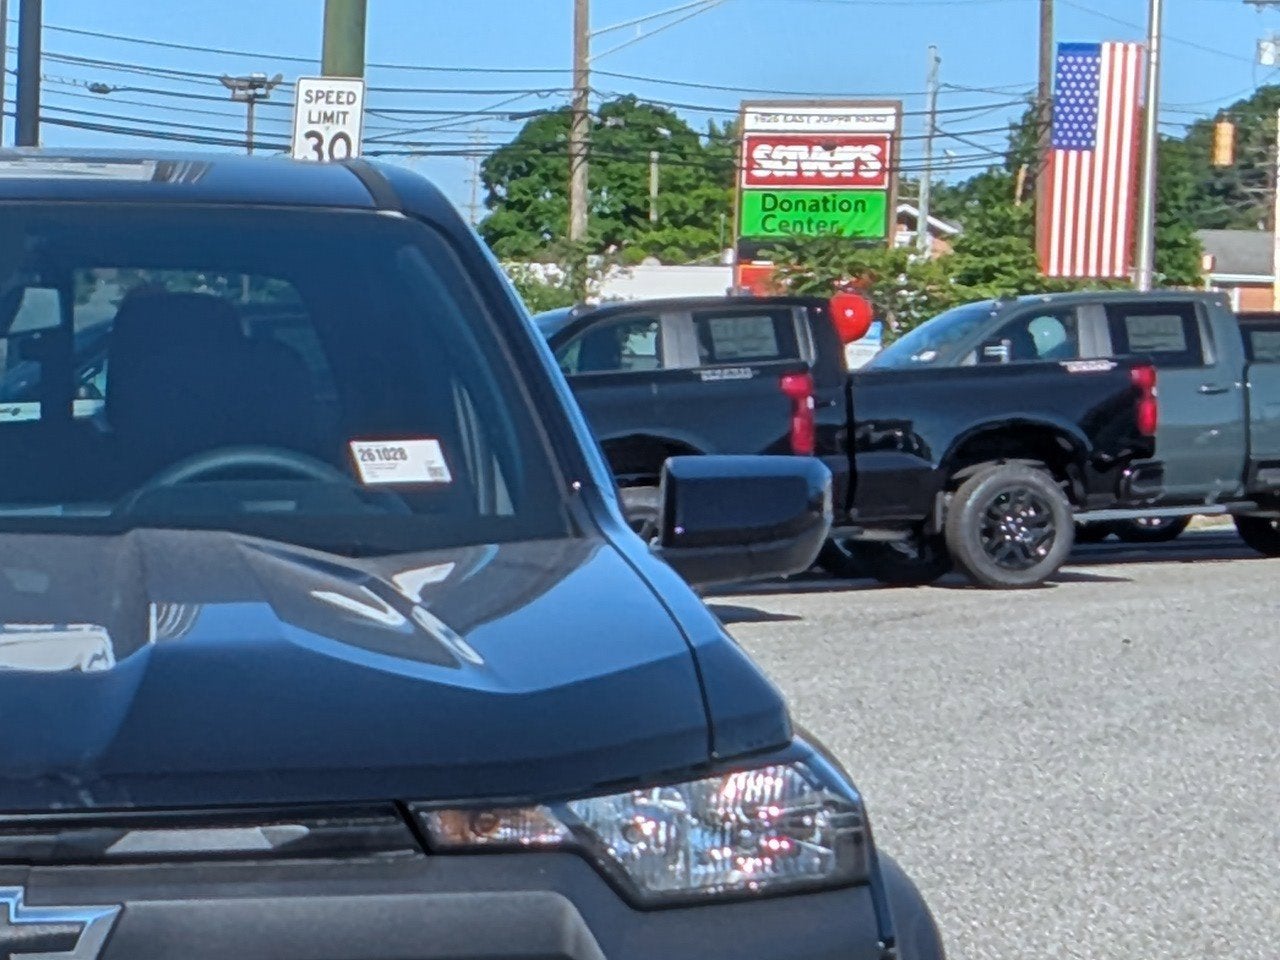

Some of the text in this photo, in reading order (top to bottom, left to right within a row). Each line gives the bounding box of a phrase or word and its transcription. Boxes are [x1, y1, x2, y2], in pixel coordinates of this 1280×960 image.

[304, 89, 357, 105] SPEED
[307, 110, 350, 125] LIMIT
[304, 130, 352, 161] 30
[761, 193, 867, 213] Donation
[761, 214, 839, 233] Center
